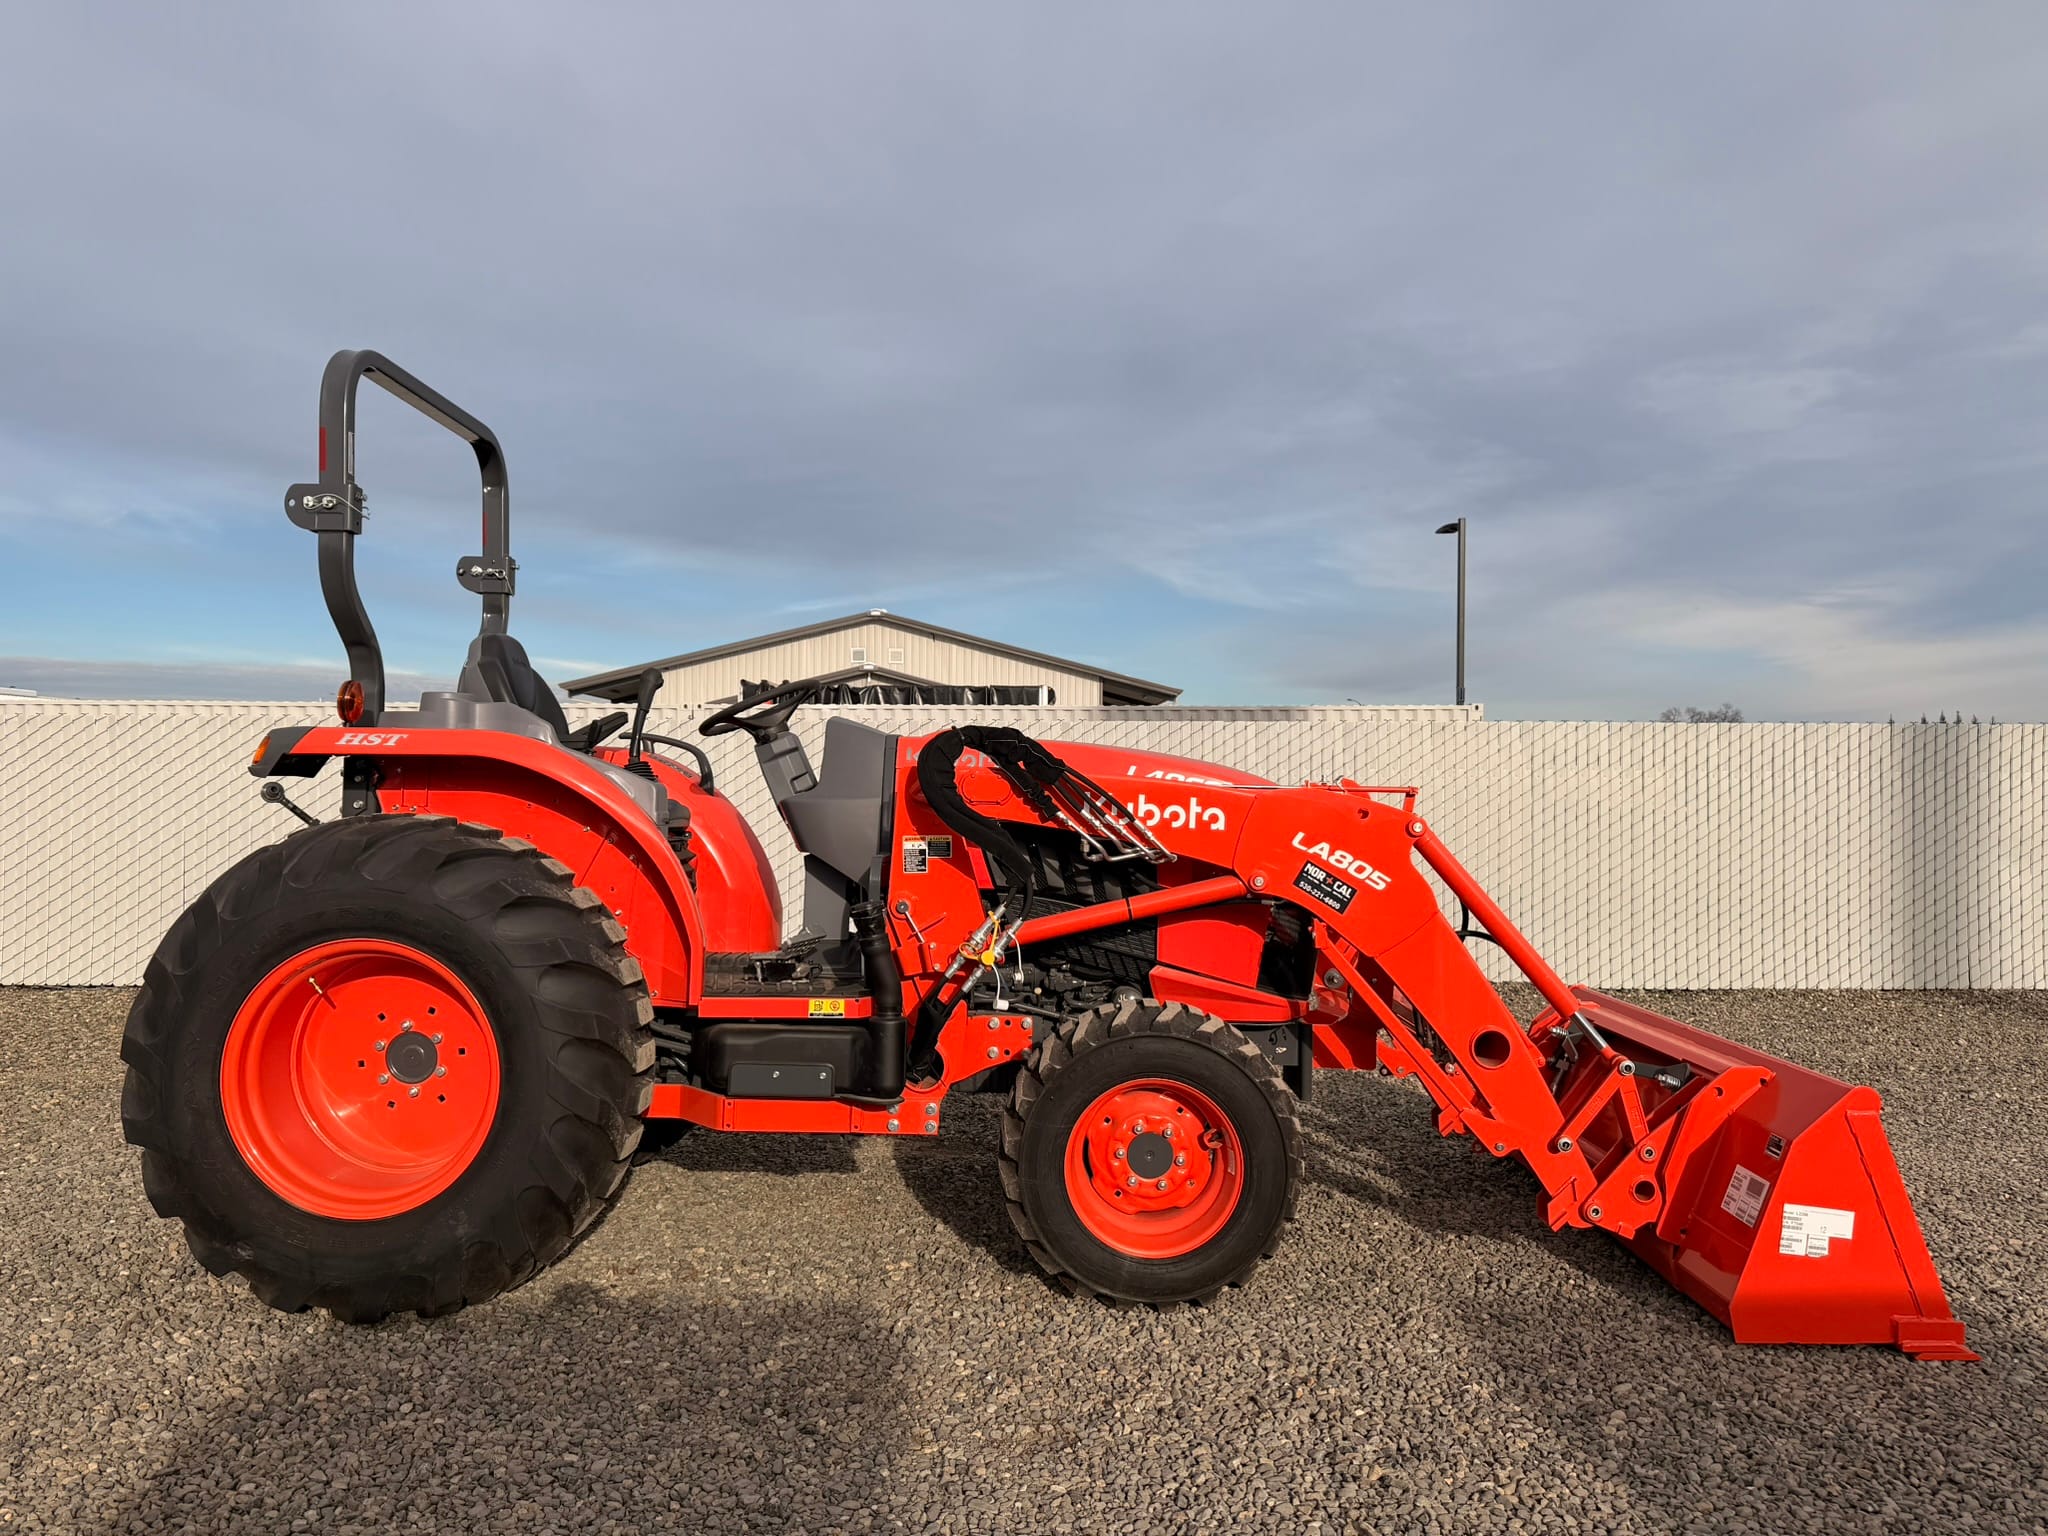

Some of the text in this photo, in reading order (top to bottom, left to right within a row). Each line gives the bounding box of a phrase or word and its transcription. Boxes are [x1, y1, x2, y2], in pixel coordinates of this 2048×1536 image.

[335, 732, 408, 746] HST
[1291, 831, 1392, 891] LA805
[1304, 863, 1327, 882] NOR
[1333, 881, 1353, 898] CAL
